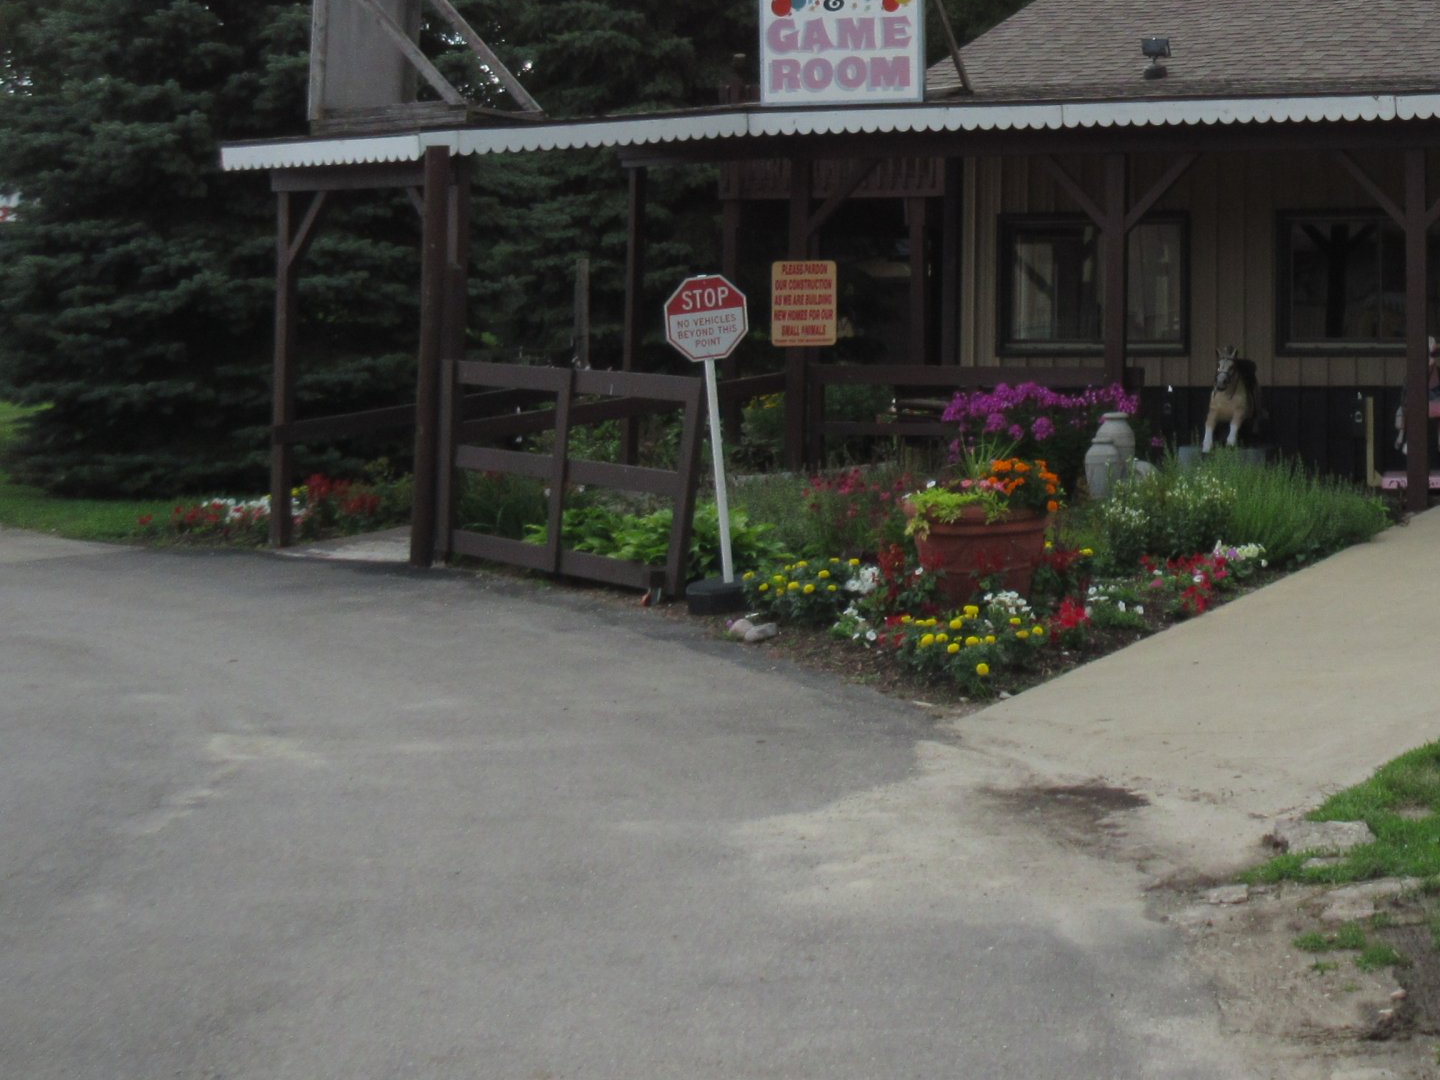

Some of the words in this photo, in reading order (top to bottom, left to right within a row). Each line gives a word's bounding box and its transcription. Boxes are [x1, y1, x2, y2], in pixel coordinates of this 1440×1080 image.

[766, 16, 912, 54] GAME
[769, 56, 911, 92] ROOM
[682, 286, 729, 310] STOP
[677, 320, 690, 329] NO
[693, 314, 737, 327] VEHICLES
[678, 327, 714, 340] BEYOND
[718, 324, 737, 334] THIS
[695, 337, 721, 348] POINT
